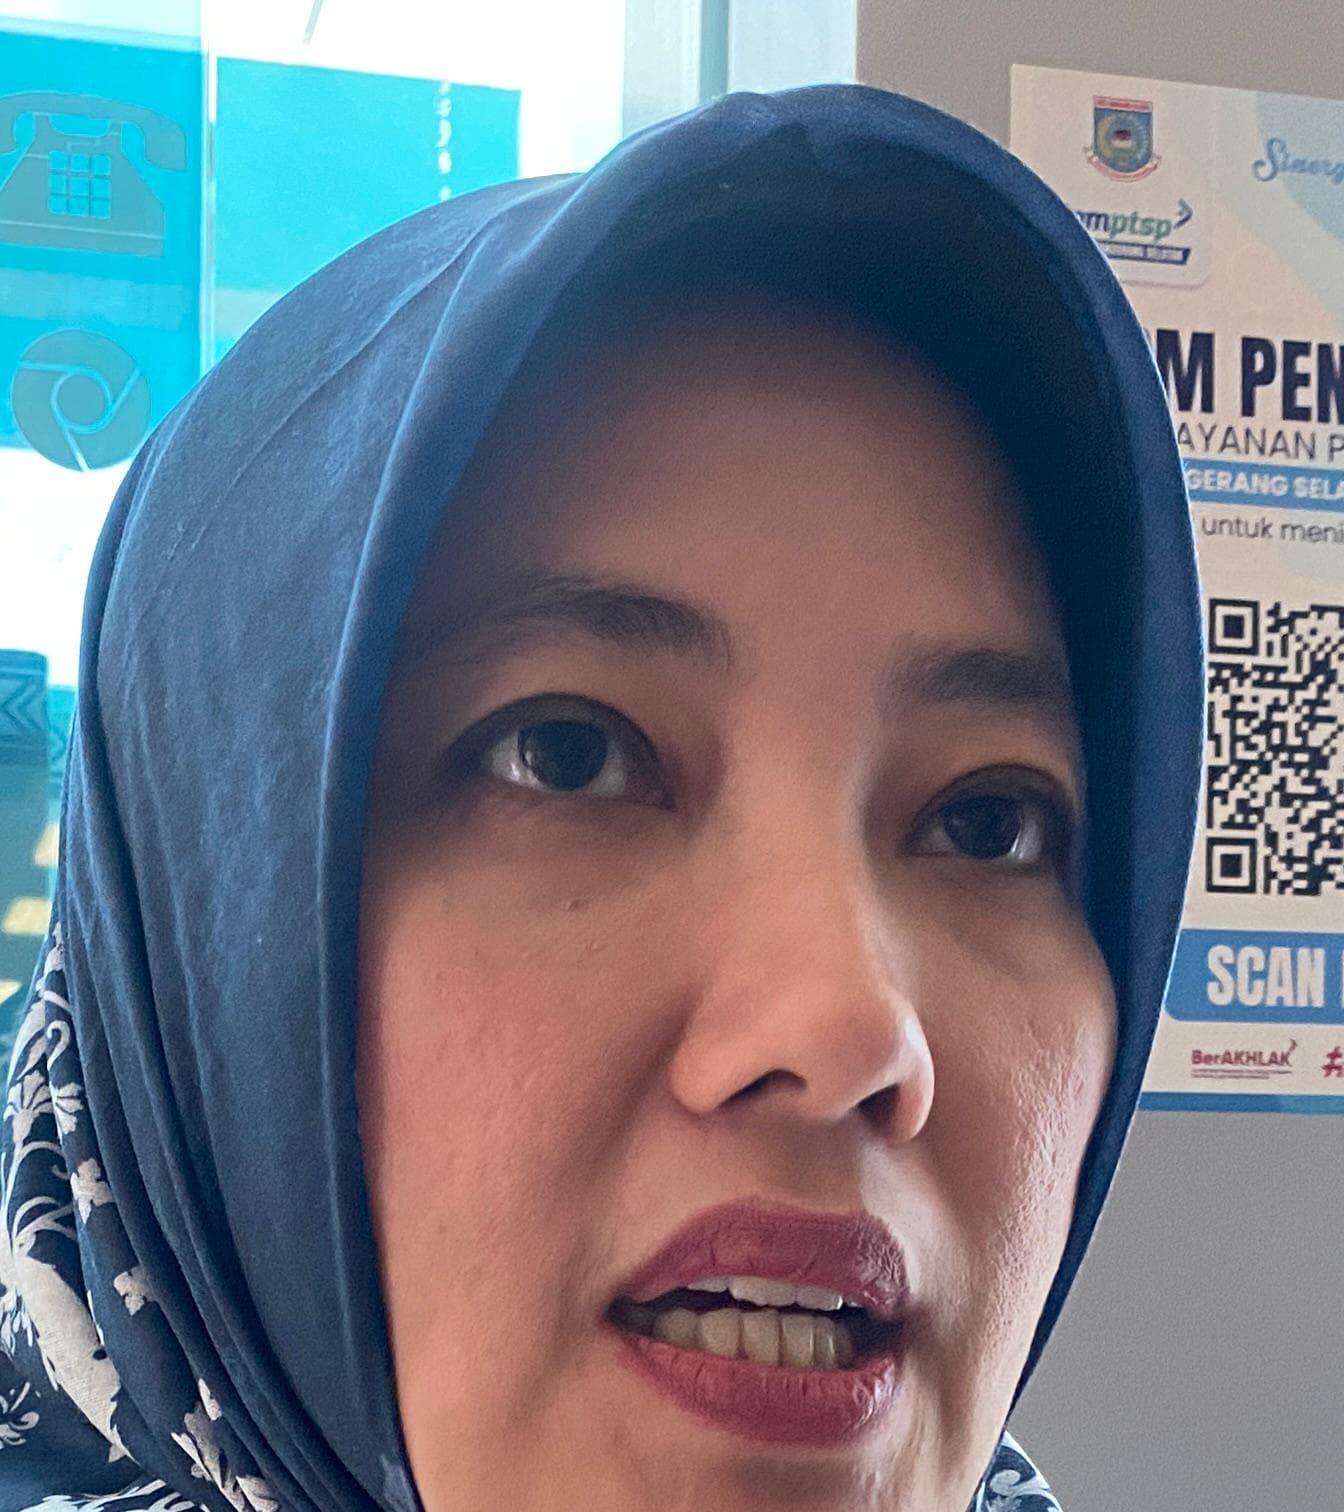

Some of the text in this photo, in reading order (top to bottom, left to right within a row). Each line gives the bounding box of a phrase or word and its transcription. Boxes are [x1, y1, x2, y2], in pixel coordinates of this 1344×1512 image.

[1177, 421, 1317, 462] AYANAN
[1184, 466, 1290, 498] GERANG
[1201, 516, 1274, 540] untuk
[1206, 944, 1326, 1009] SCAN
[1191, 1049, 1293, 1067] BerAKHLAK
